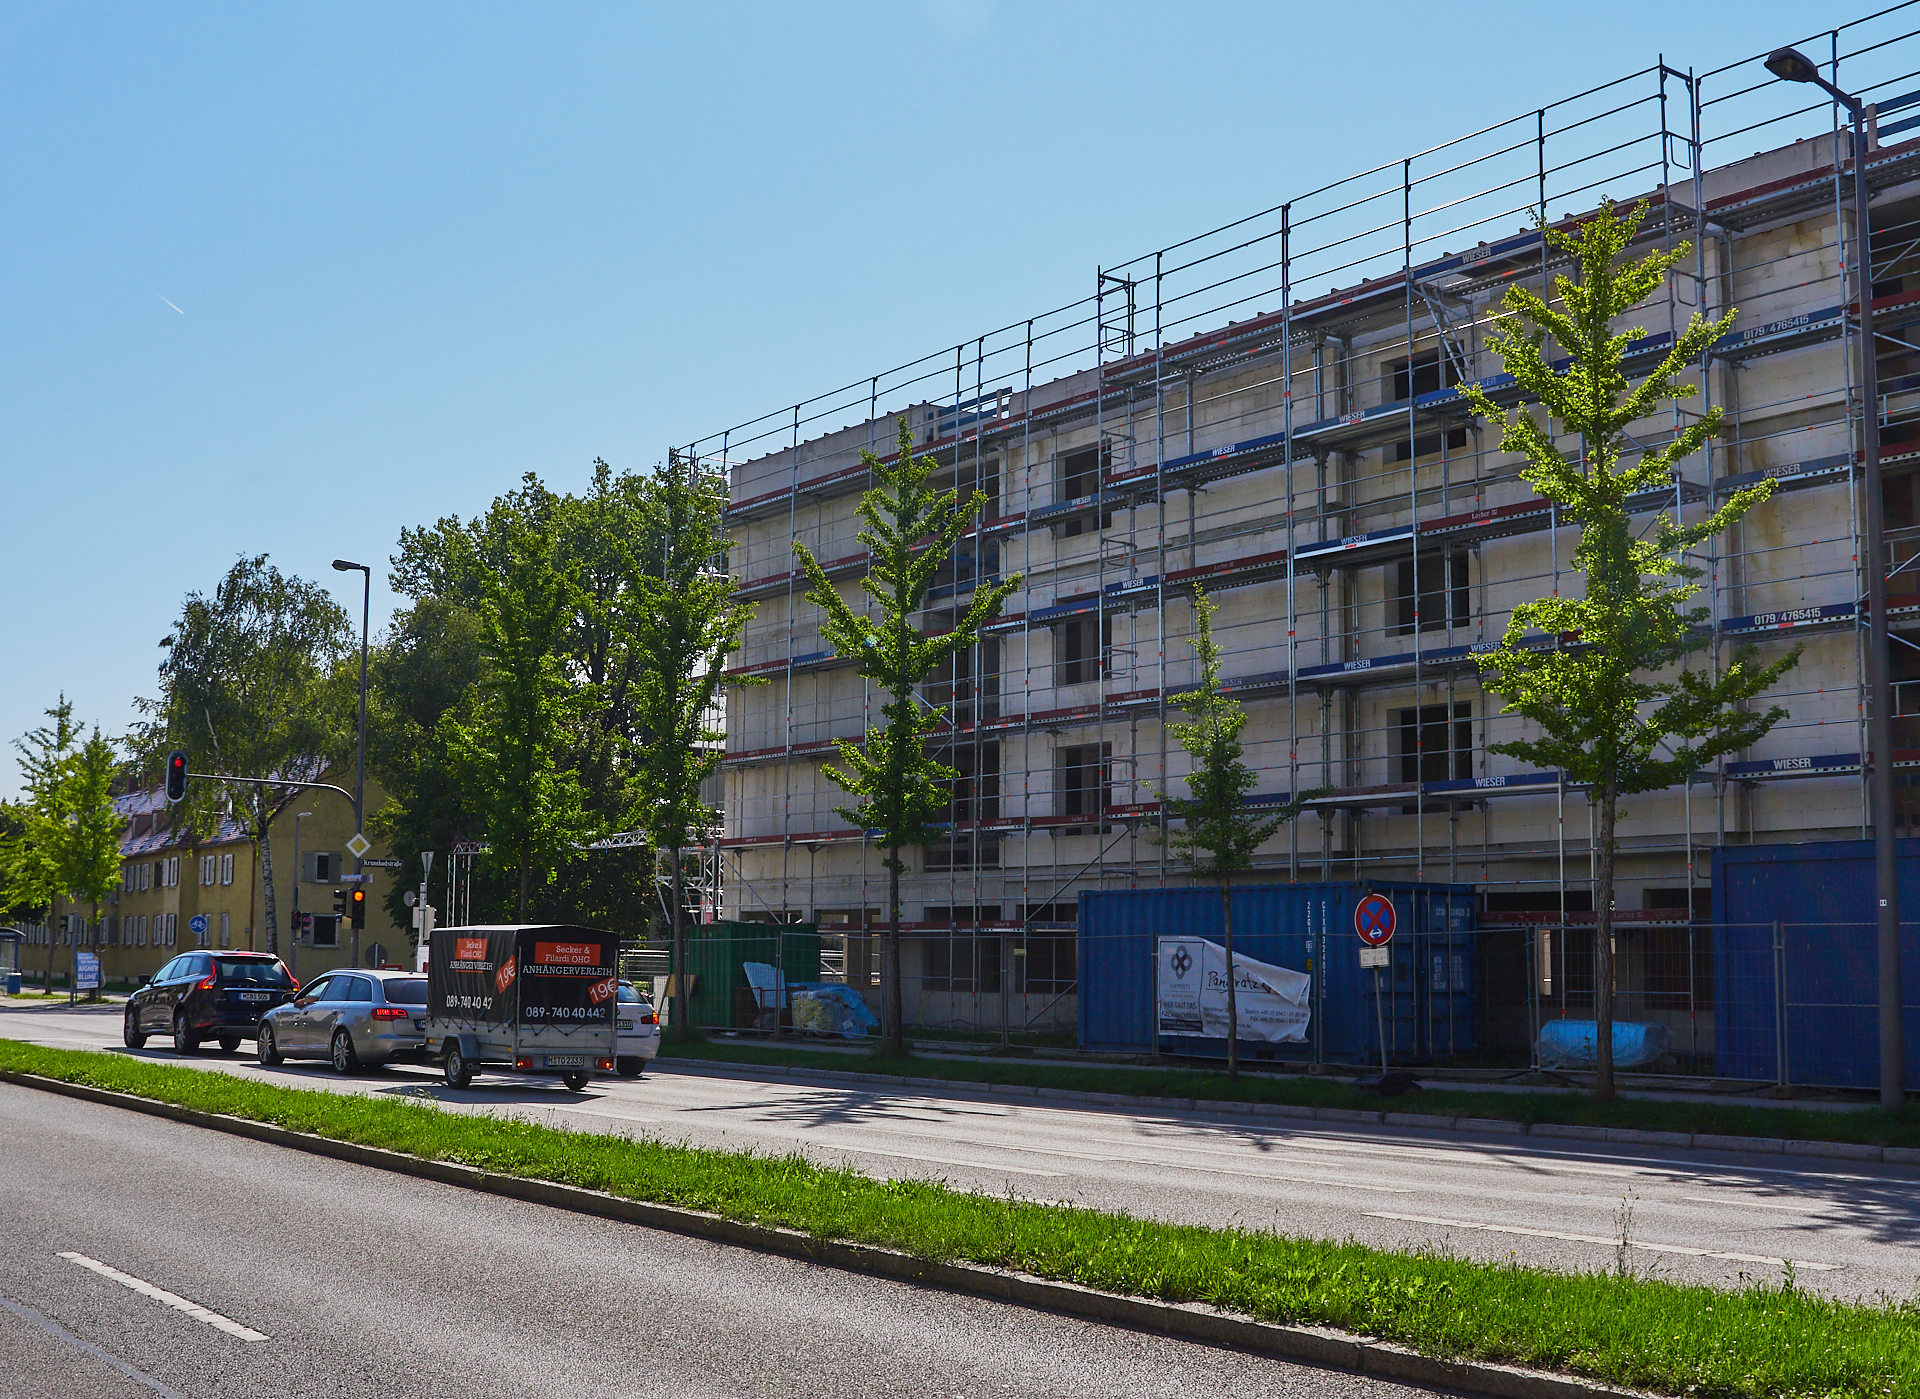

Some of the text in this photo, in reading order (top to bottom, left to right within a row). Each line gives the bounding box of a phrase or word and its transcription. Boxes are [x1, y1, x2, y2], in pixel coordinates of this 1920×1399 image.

[1462, 248, 1491, 263] WIESER
[1339, 410, 1365, 424] WIESER
[1212, 445, 1235, 456] WIESER
[1764, 463, 1800, 478] WIESER
[1071, 495, 1091, 506] WIESER
[1341, 534, 1367, 545] WIESER
[1122, 578, 1144, 589] WIESER
[1754, 607, 1820, 625] 0179/4765415
[1470, 641, 1500, 652] WIESER
[1344, 659, 1370, 670] WIESER
[1773, 758, 1811, 770] WIESER
[1475, 776, 1505, 787] WIESER
[556, 945, 582, 953] Secker
[545, 954, 570, 962] Filardi
[498, 960, 515, 987] 19€
[522, 965, 613, 976] ANHÄNGERVERLEIH
[1208, 971, 1258, 989] Panratz
[590, 978, 618, 1001] 19€
[571, 1007, 586, 1018] 40
[586, 1007, 606, 1018] 442
